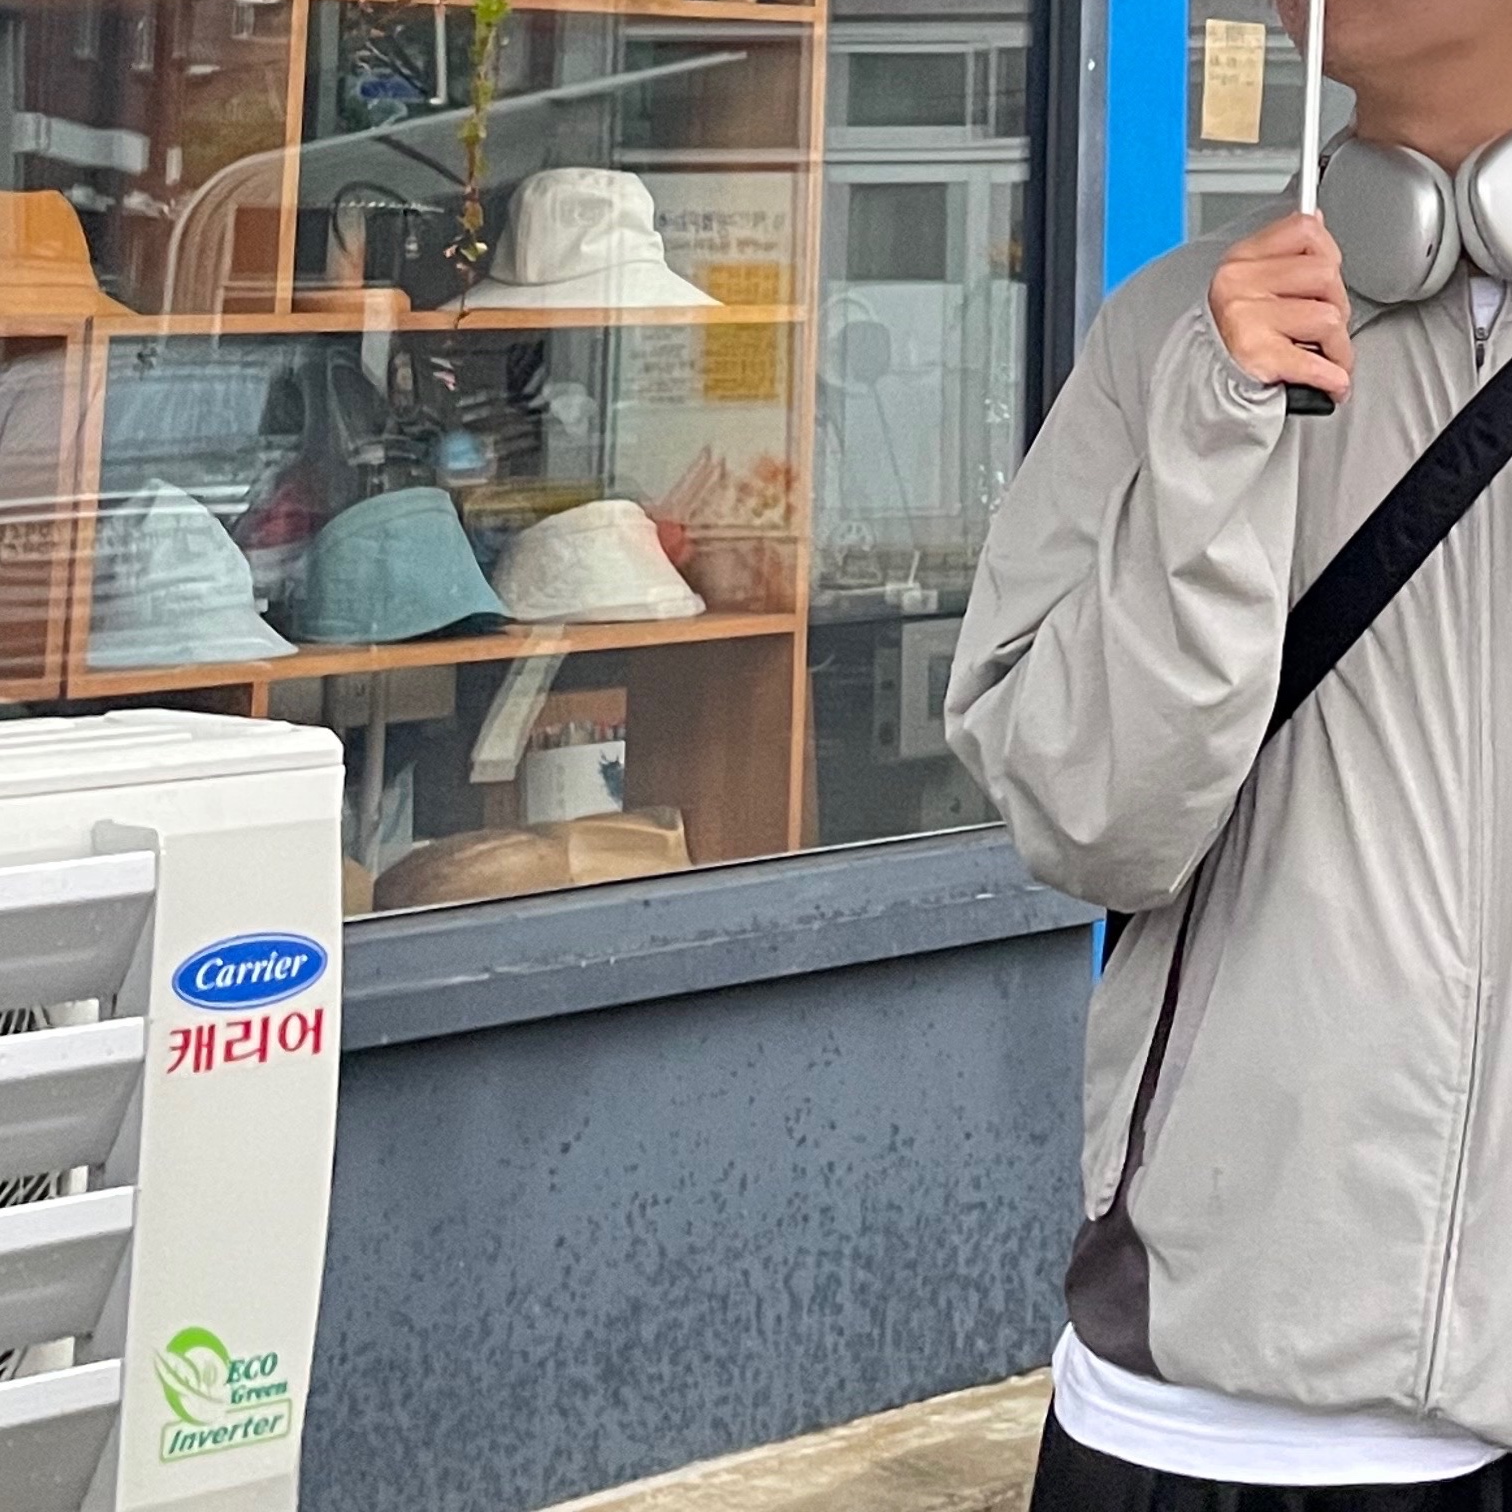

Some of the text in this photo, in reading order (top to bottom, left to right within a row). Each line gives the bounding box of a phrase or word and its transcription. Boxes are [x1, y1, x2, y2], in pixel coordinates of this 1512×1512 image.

[195, 950, 309, 992] Carrier
[166, 1007, 325, 1076] 캐리어
[225, 1351, 279, 1385] ECO
[230, 1380, 288, 1405] Green
[167, 1413, 285, 1455] Inverter
